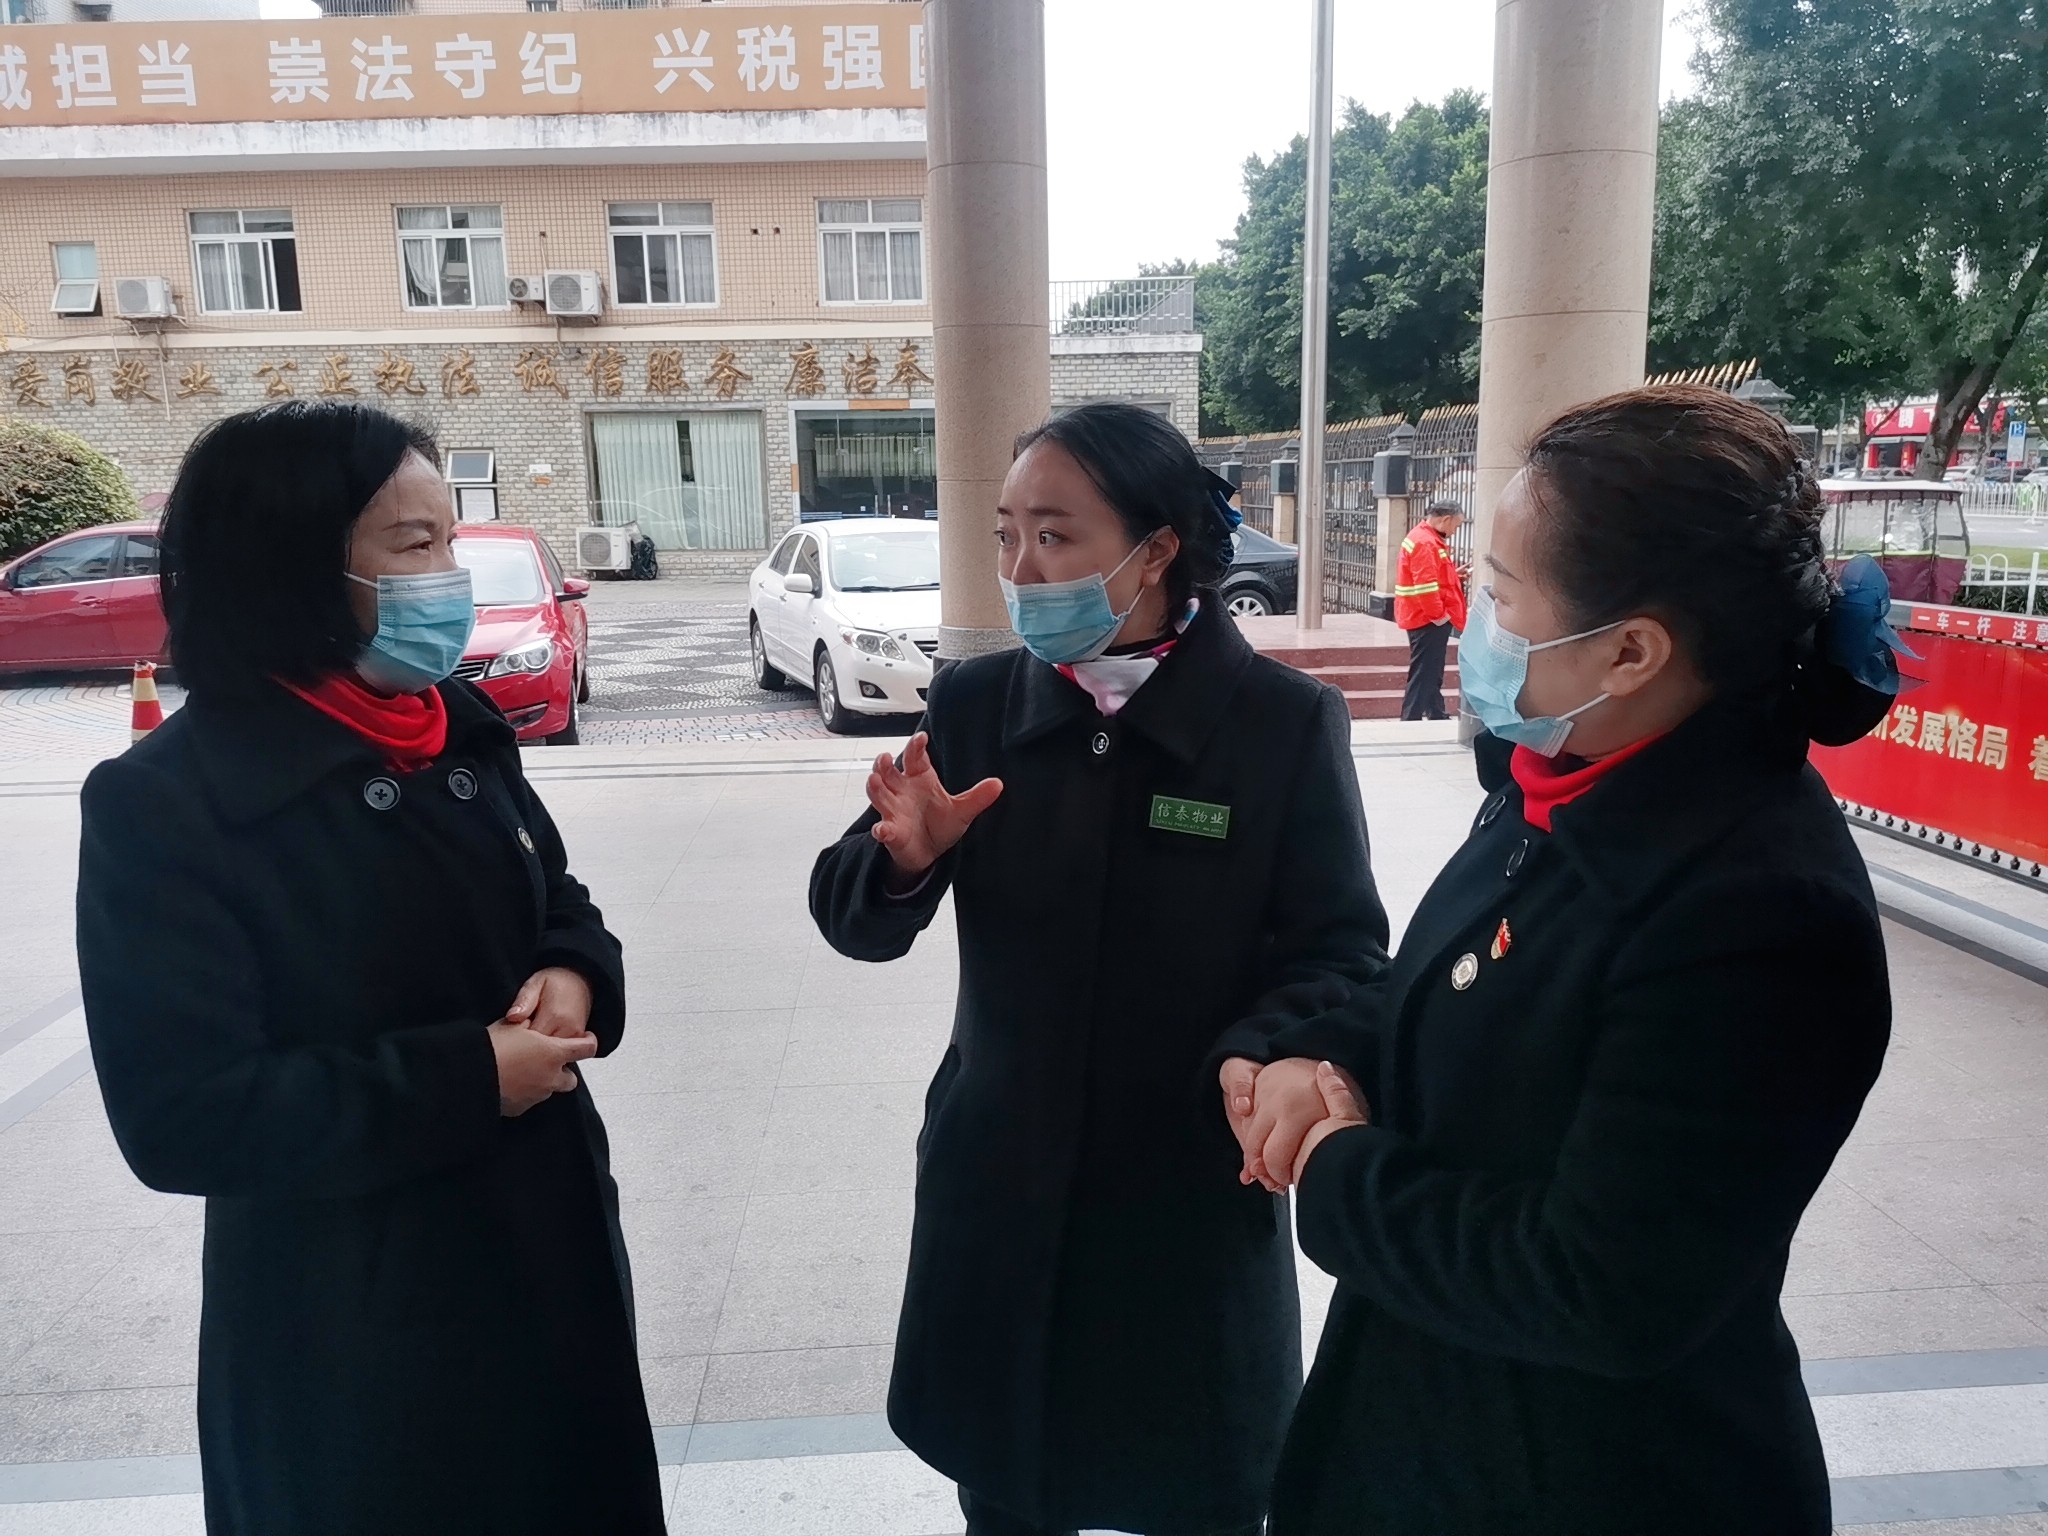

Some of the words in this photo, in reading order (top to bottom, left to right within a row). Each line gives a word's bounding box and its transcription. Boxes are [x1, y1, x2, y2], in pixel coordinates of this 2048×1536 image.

[269, 31, 582, 103] 崇法守纪
[653, 24, 929, 94] 兴税强
[253, 347, 481, 399] 公正执法
[513, 344, 753, 399] 诚信服务
[1917, 611, 1991, 635] 一车一杆
